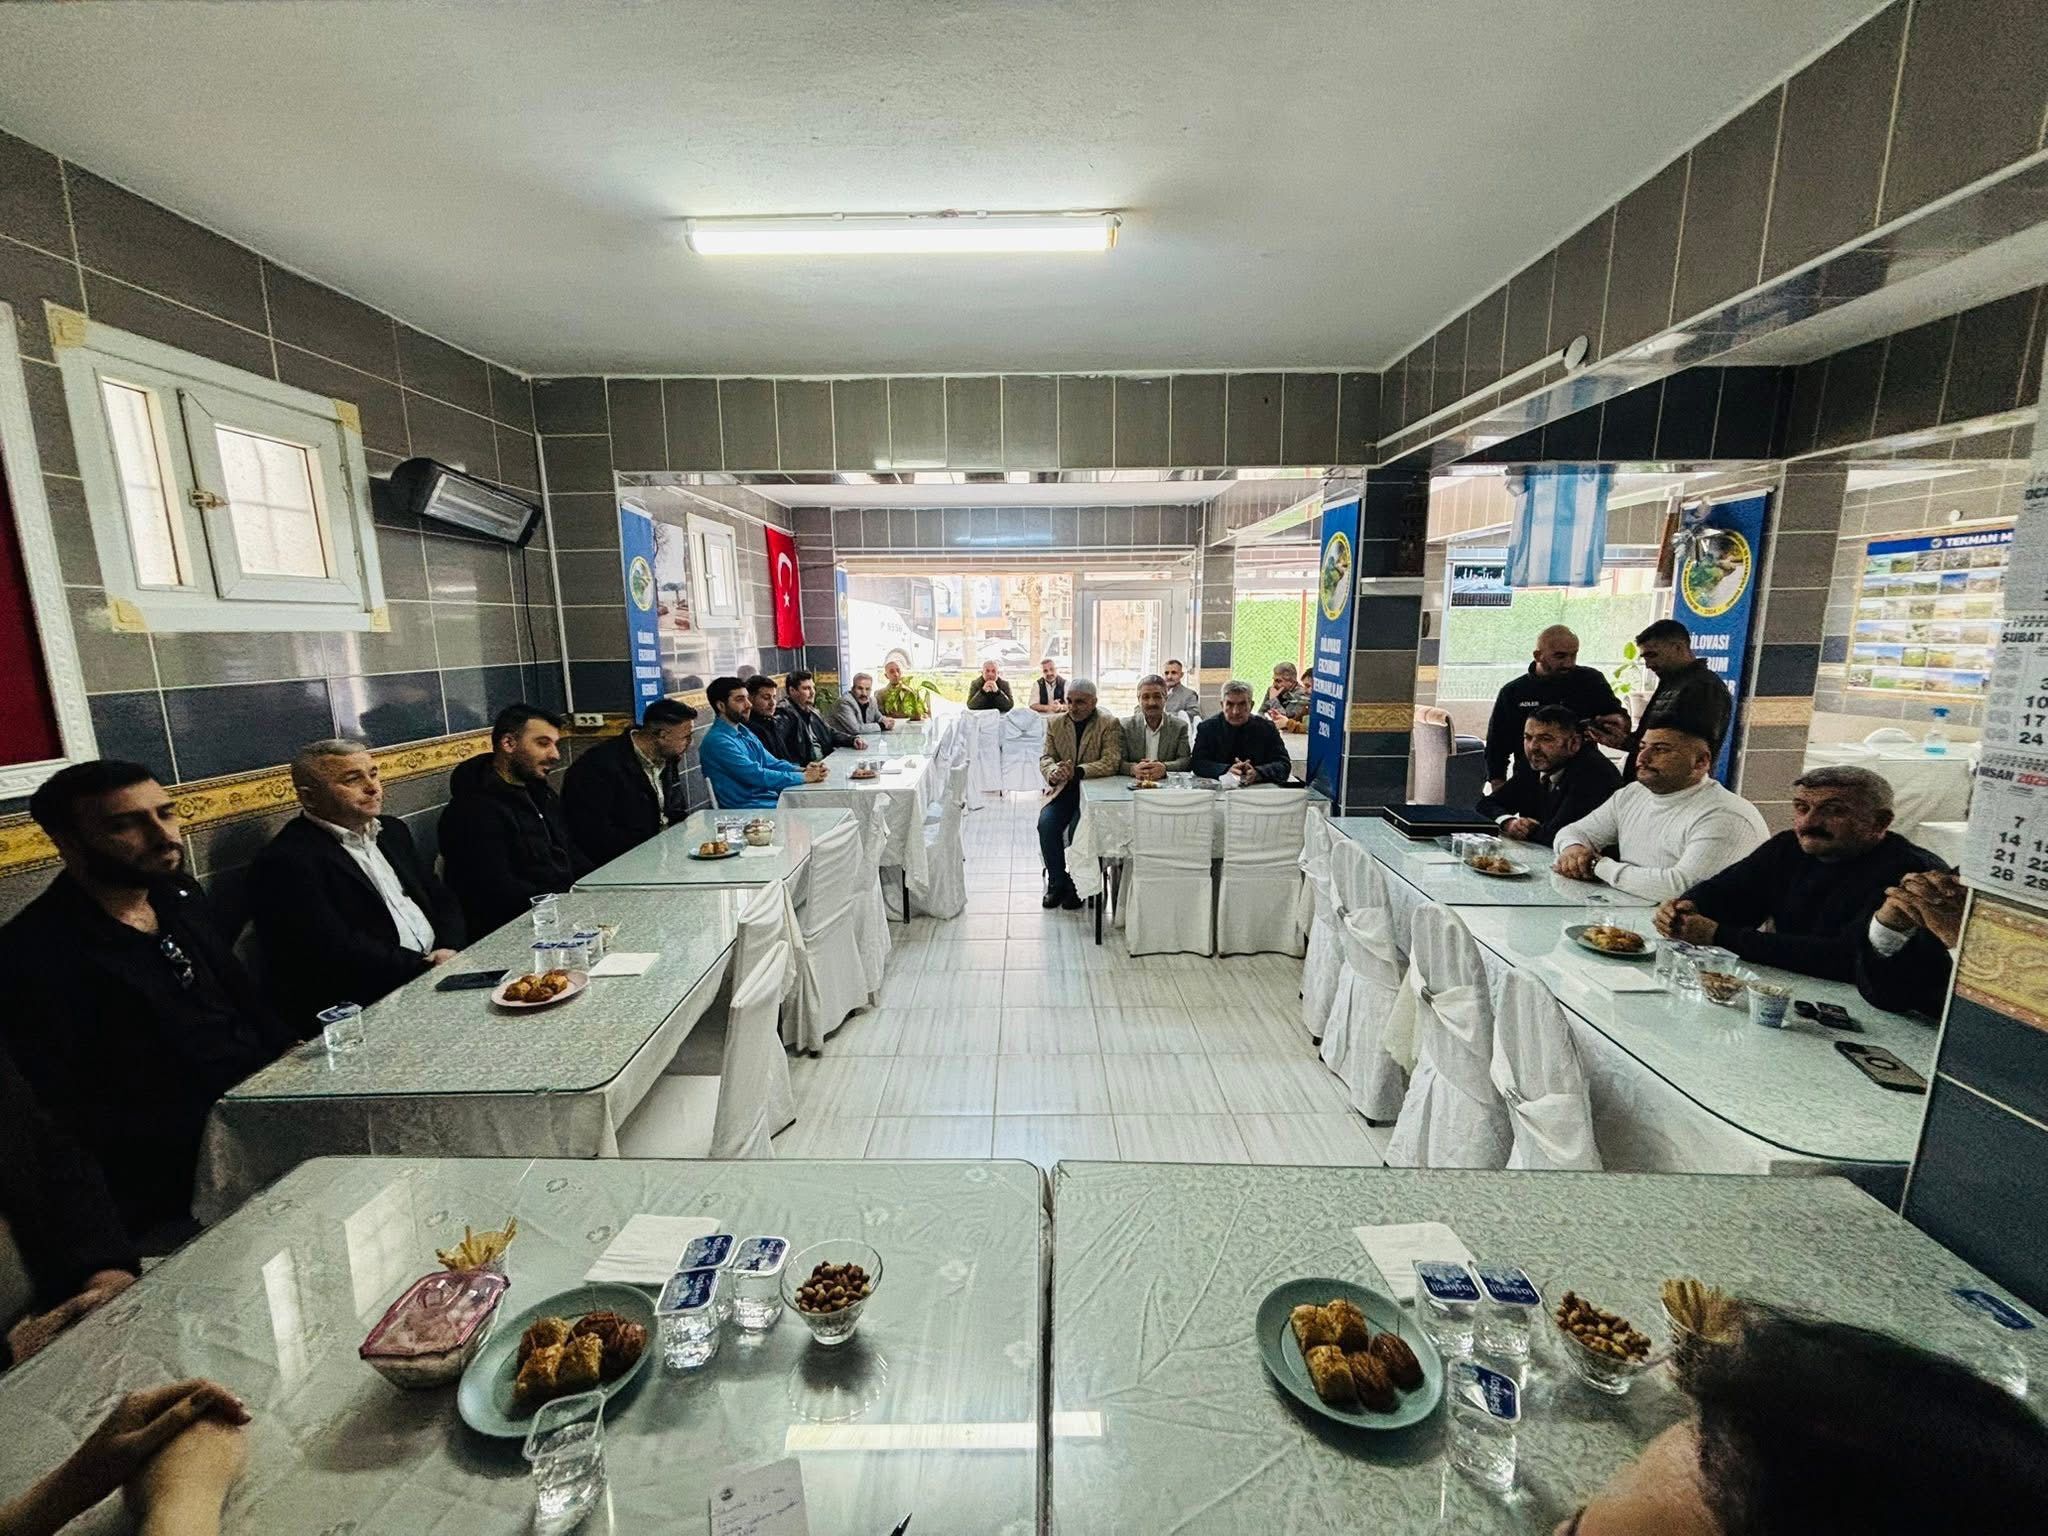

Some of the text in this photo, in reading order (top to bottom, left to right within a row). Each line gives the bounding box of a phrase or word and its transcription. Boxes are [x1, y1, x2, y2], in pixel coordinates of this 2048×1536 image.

[1946, 533, 1998, 547] TEKMAN
[1689, 632, 1729, 650] İLOVASI
[2026, 695, 2048, 709] 10
[2023, 713, 2046, 728] 17
[2019, 731, 2044, 746] 24
[2014, 816, 2024, 828] 7
[2000, 832, 2020, 847] 14
[1994, 849, 2016, 864] 21
[1990, 866, 2015, 881] 28
